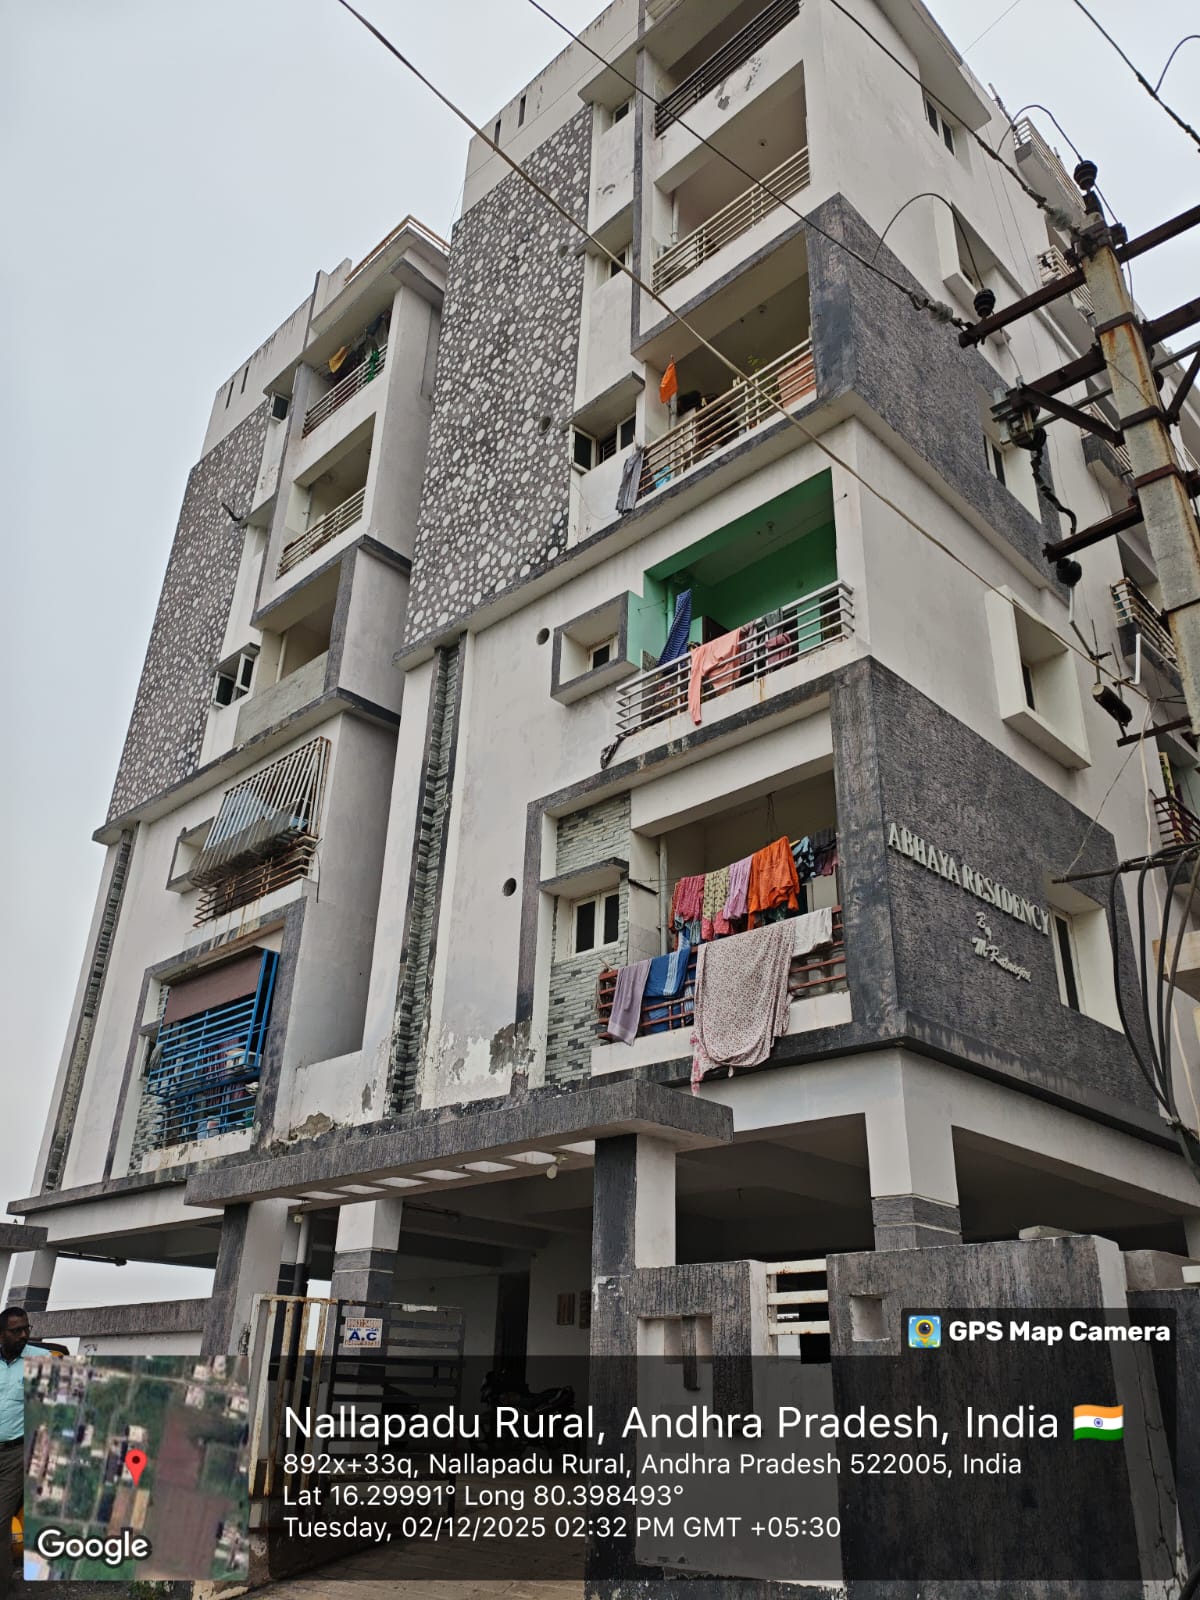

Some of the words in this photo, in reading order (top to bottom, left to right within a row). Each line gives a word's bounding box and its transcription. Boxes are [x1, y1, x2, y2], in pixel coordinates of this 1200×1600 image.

[888, 822, 961, 886] ABHAYA
[962, 863, 1049, 935] RESIDENCY
[349, 1331, 377, 1341] A.C
